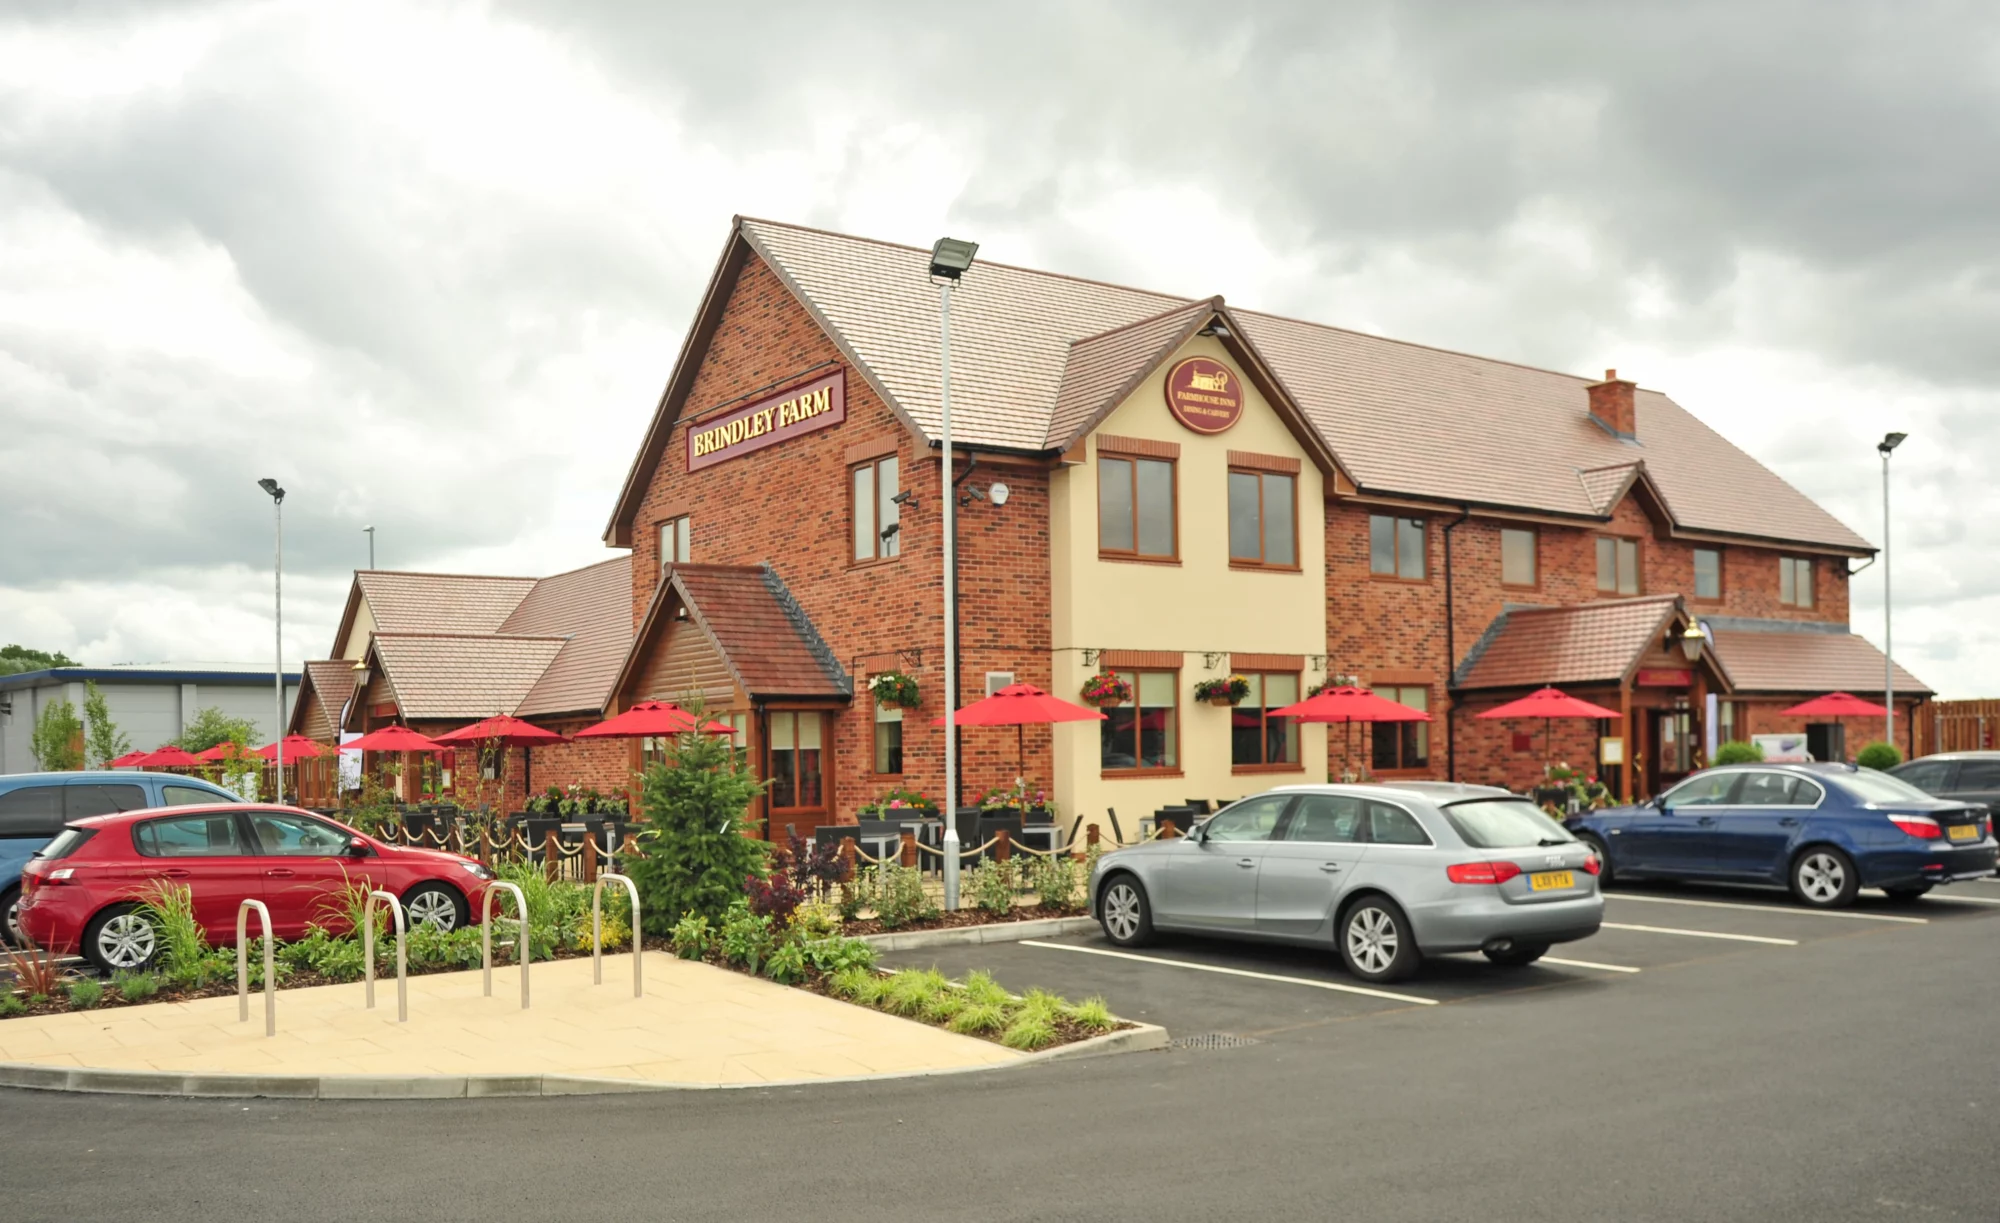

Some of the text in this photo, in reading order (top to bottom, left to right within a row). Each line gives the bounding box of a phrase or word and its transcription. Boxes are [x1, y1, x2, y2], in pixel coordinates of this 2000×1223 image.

[1177, 391, 1236, 407] FARMHOUSE INNS
[693, 386, 832, 457] BRINDLEY FARM
